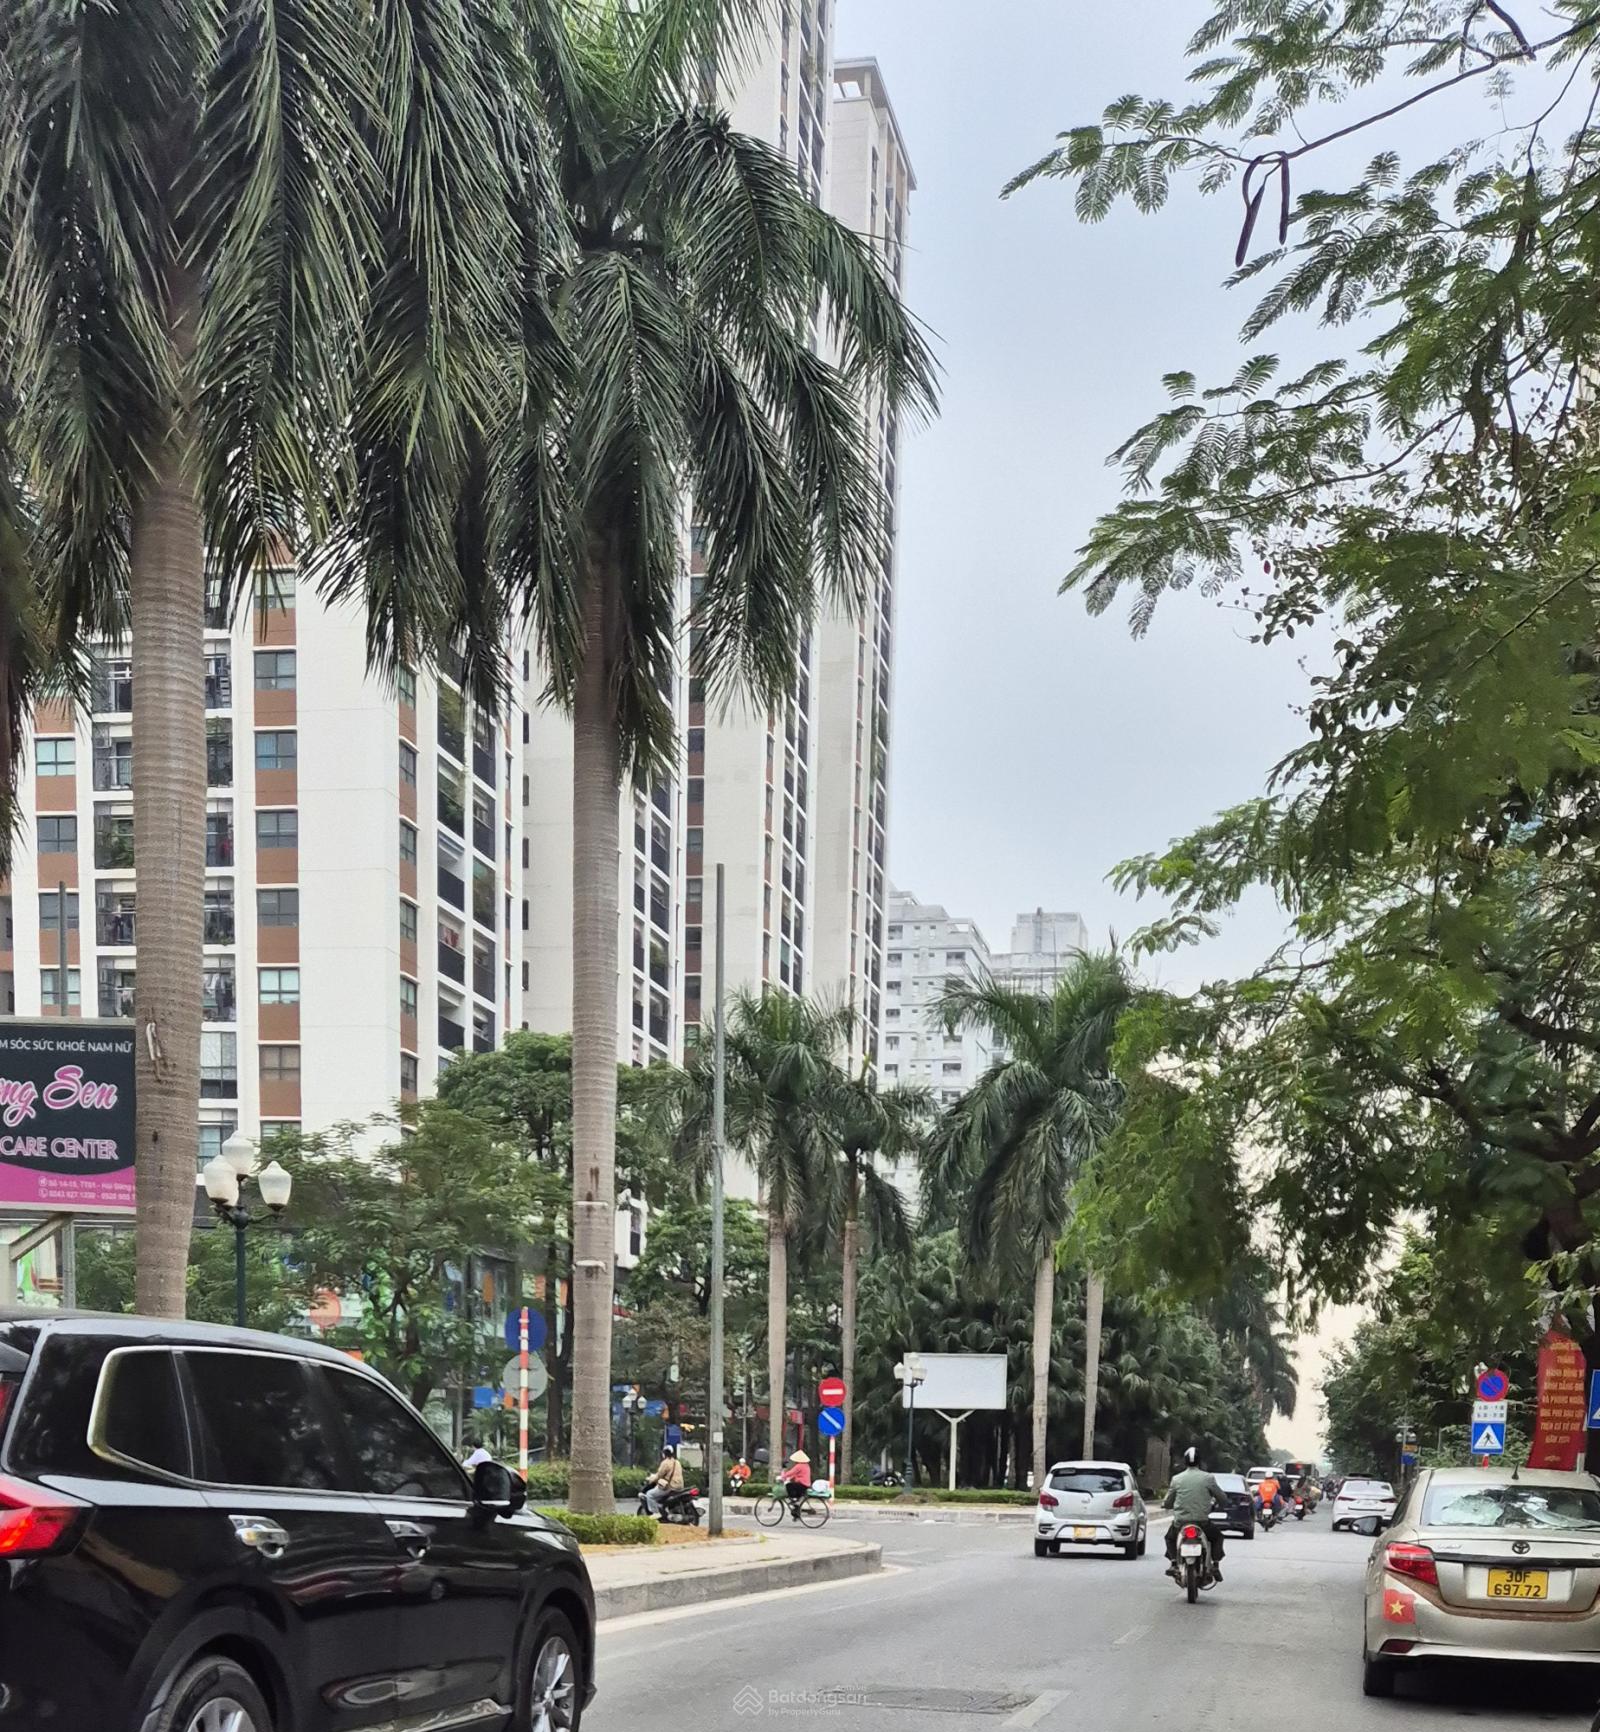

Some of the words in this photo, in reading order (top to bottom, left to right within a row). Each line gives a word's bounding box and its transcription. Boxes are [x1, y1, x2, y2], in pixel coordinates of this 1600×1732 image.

[10, 1038, 31, 1050] SÓC
[33, 1039, 54, 1051] SỨC
[88, 1041, 113, 1052] NAM
[115, 1041, 133, 1053] NỮ
[43, 1065, 118, 1109] Sen
[0, 1136, 48, 1157] CARE
[51, 1137, 119, 1160] CENTER
[1505, 1571, 1531, 1583] 30F
[1494, 1584, 1542, 1597] 697.72
